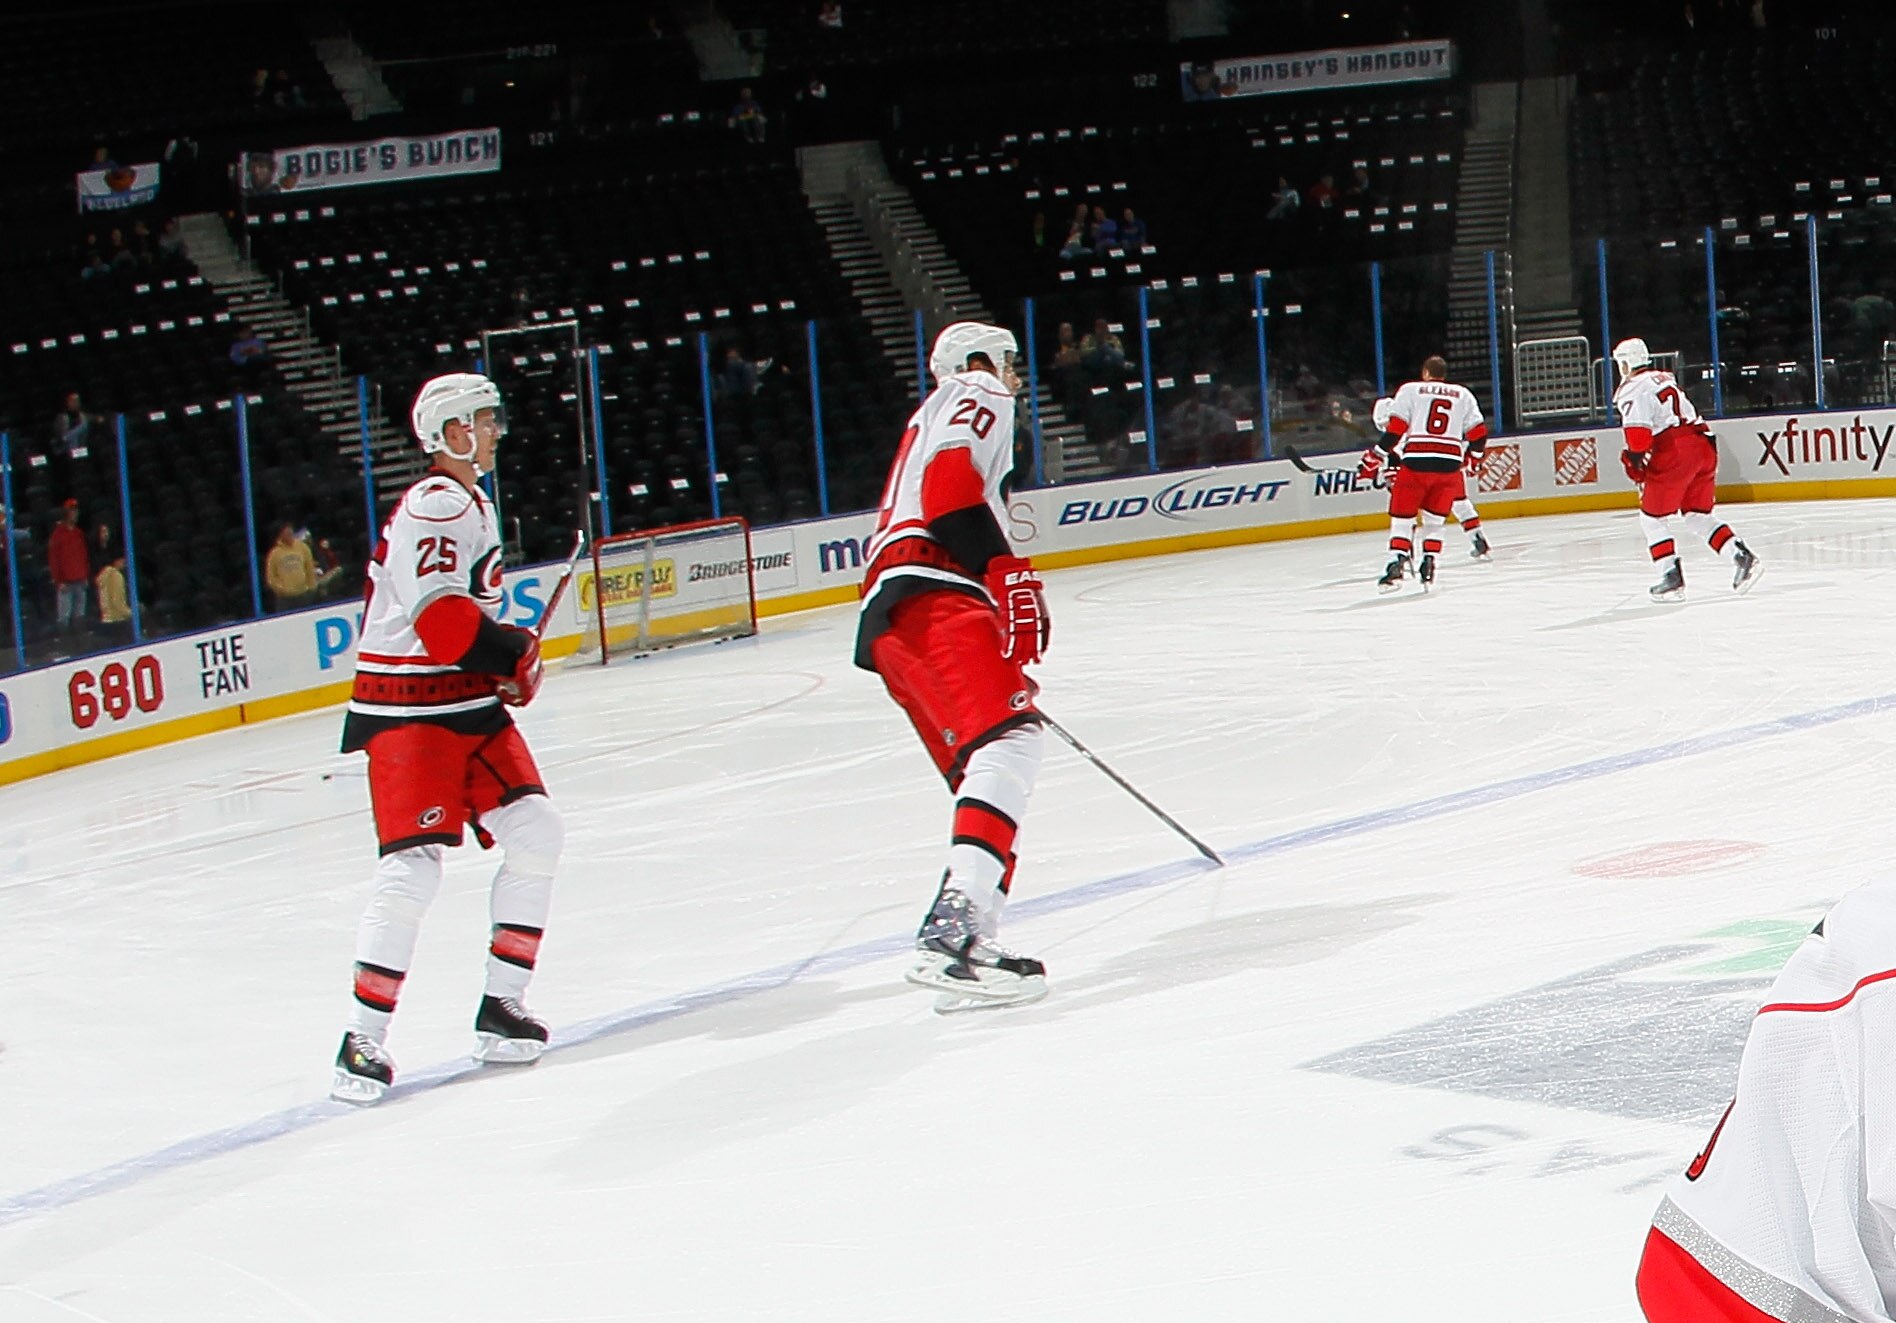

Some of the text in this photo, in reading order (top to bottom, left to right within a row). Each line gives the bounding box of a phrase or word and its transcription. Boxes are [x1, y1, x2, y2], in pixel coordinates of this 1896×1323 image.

[1225, 48, 1447, 84] HAINSEY'S HANGOUT
[285, 134, 499, 179] BOGIE'S BUNCH
[950, 399, 996, 440] 20
[1426, 398, 1452, 434] 6
[1556, 437, 1597, 485] HOME
[1756, 415, 1896, 476] xfinity
[1058, 479, 1292, 526] BUD LIGHT
[417, 536, 457, 578] 25
[196, 634, 247, 669] THE
[69, 655, 164, 729] 680
[201, 664, 250, 699] FAN
